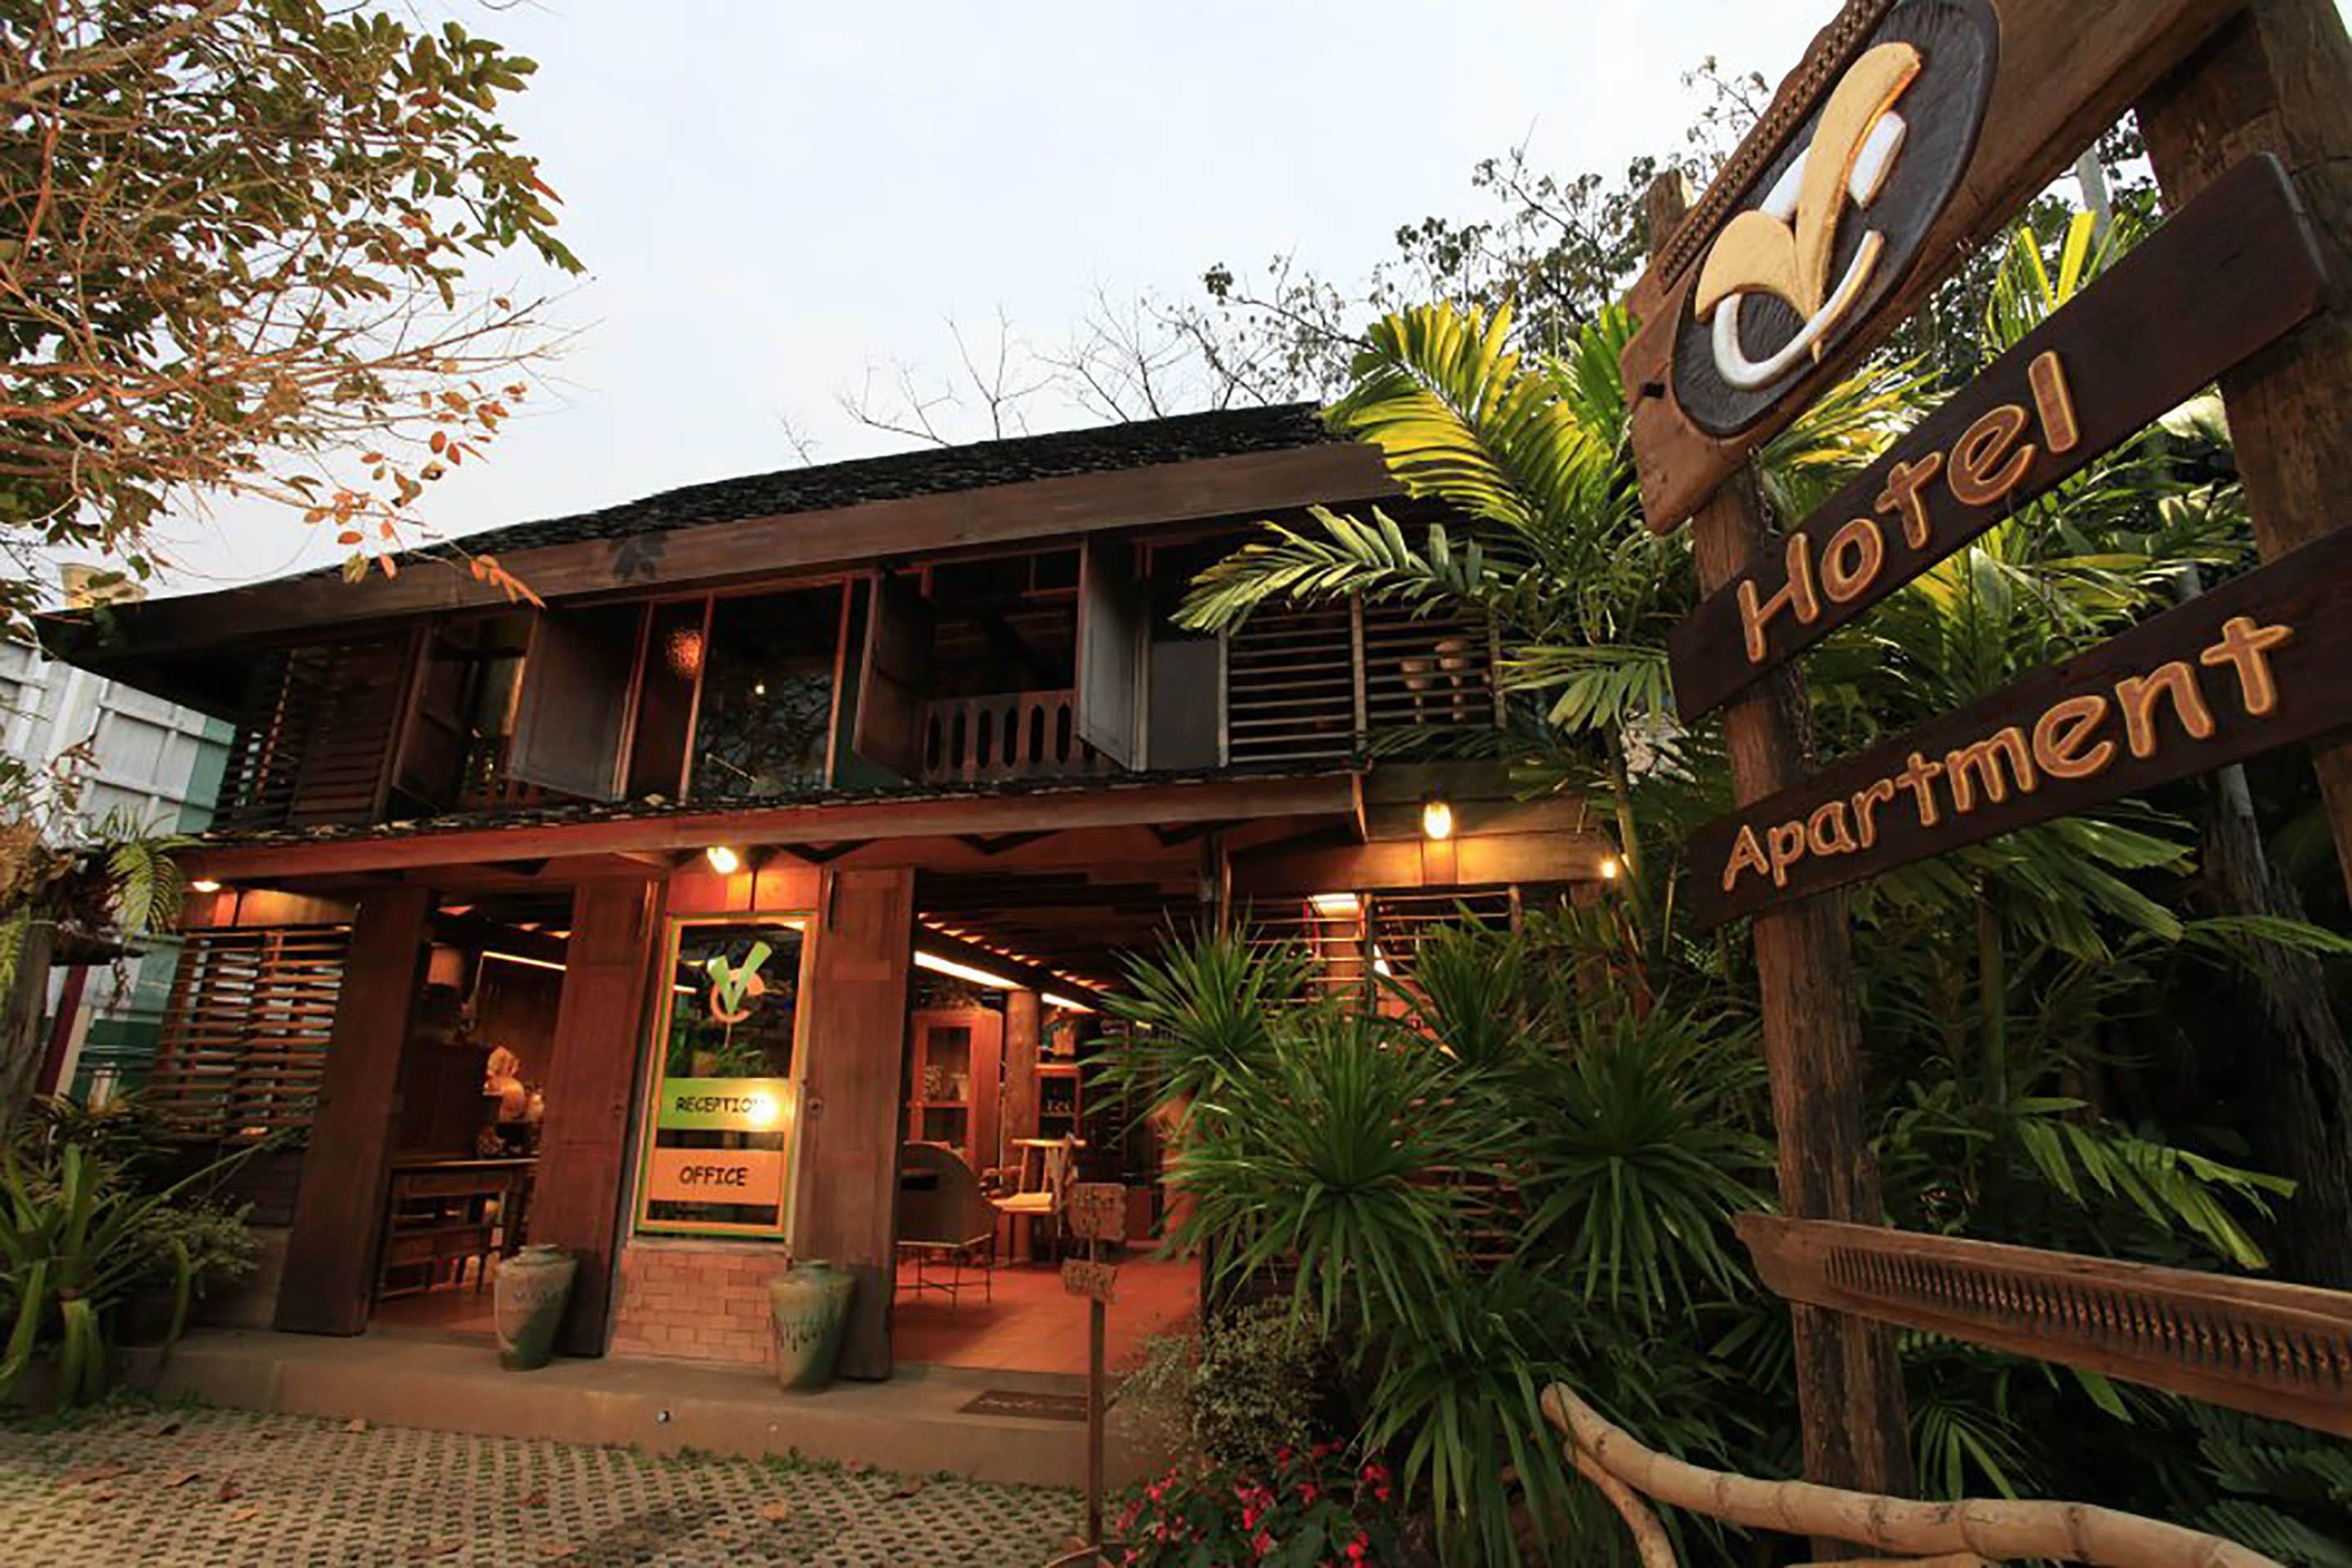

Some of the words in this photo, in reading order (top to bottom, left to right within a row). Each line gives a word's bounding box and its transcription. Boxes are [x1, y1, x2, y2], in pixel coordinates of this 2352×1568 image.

[1736, 350, 2079, 663] Hotel
[1723, 616, 2292, 892] Apartment
[675, 1096, 764, 1113] RECEPTIO
[679, 1165, 748, 1187] OFFICE
